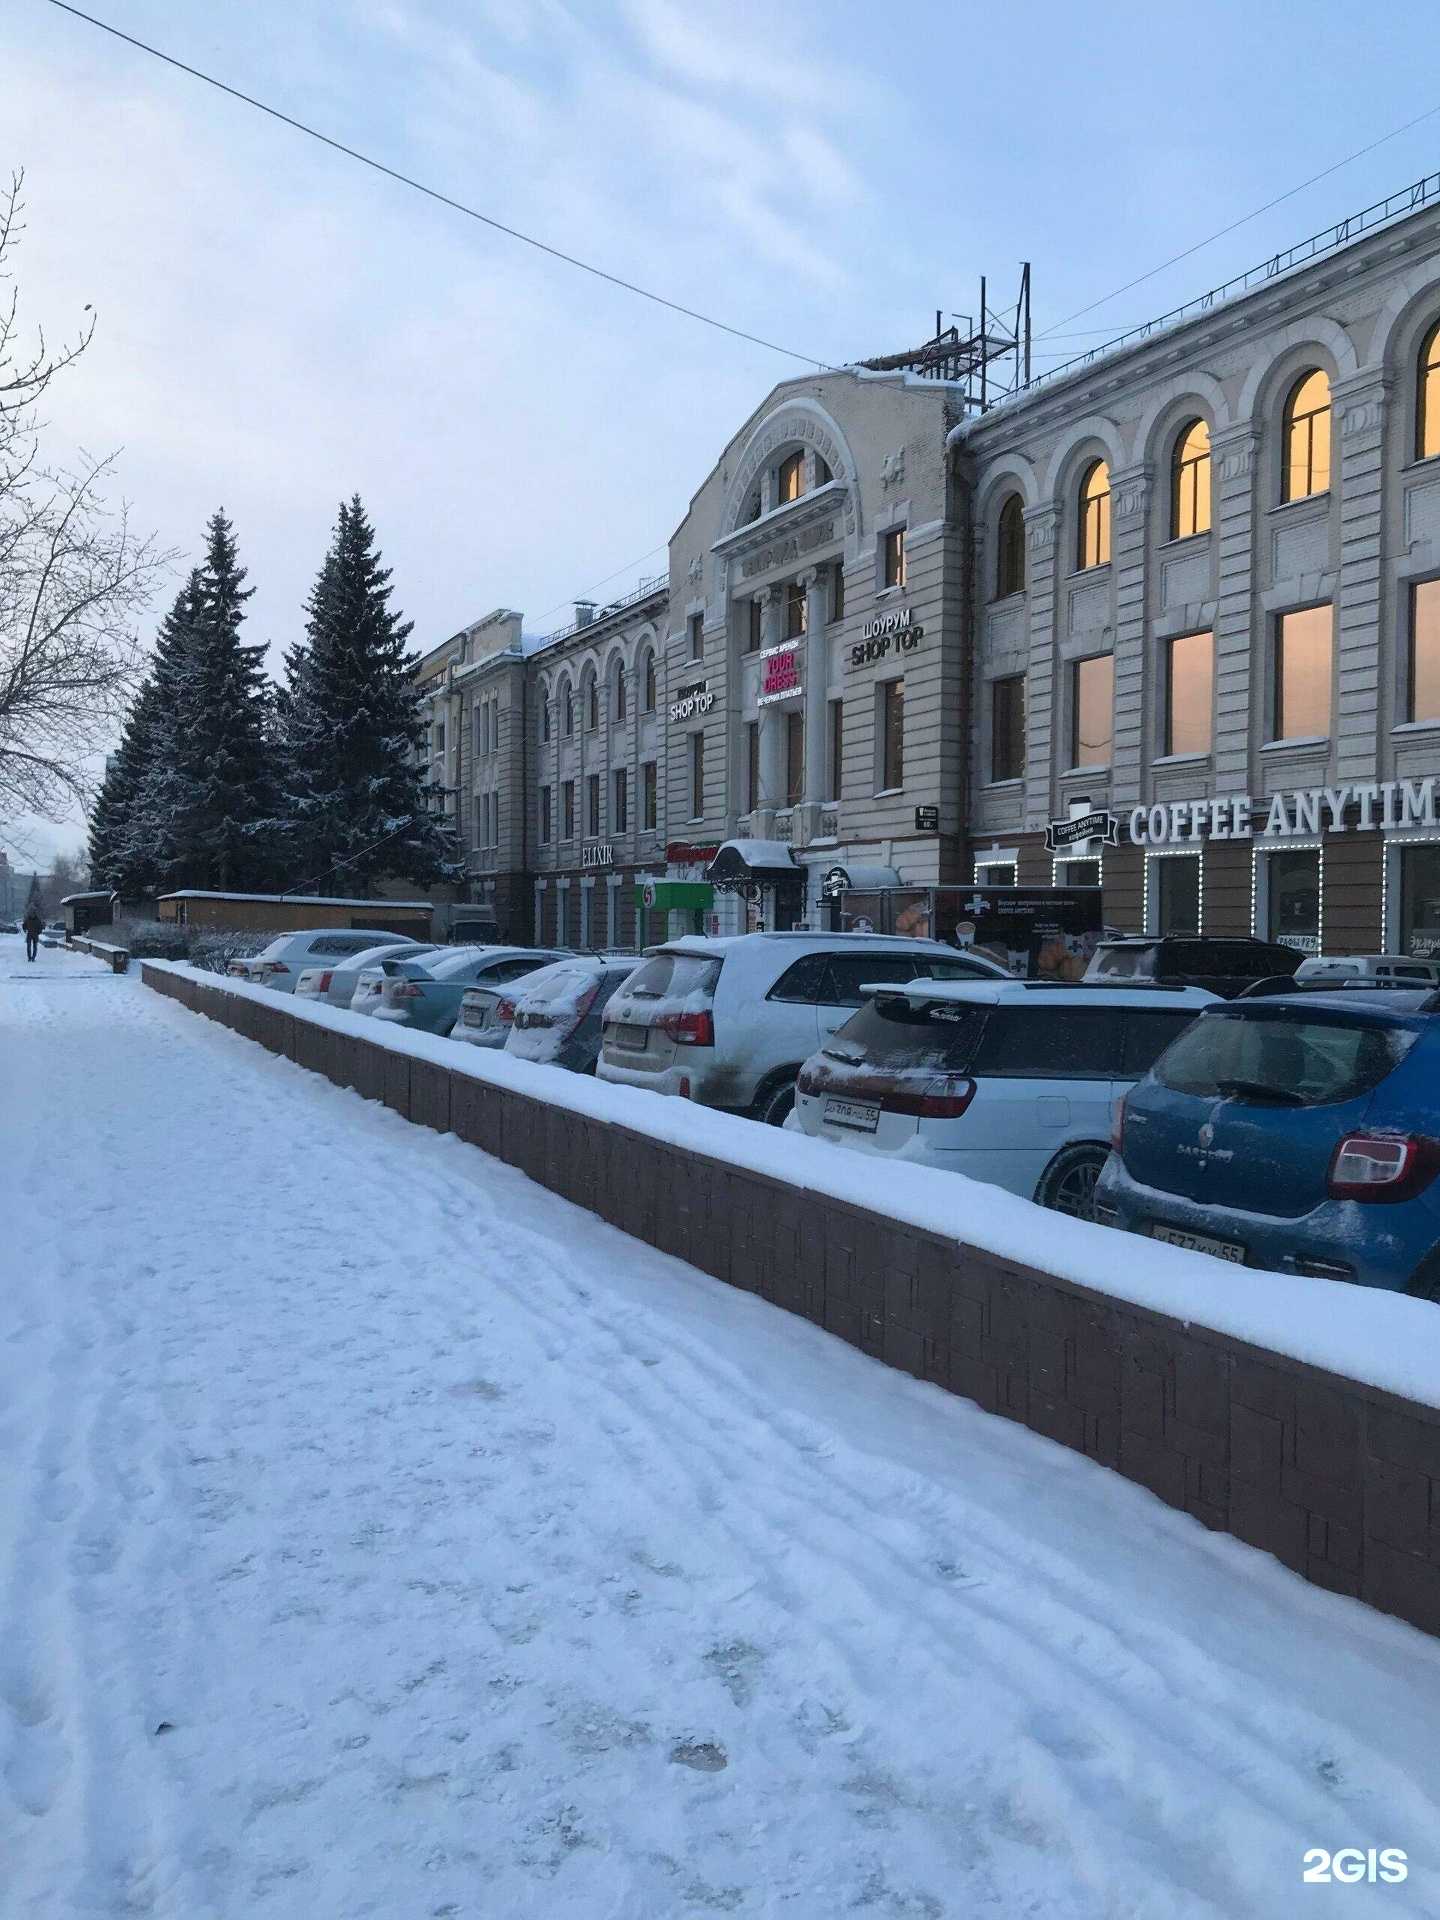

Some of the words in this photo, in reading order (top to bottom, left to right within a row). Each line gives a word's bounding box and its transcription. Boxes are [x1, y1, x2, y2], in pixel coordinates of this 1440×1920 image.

[863, 608, 911, 640] ШОУРУМ
[852, 636, 891, 666] SHOP
[893, 626, 924, 653] TOP
[768, 652, 794, 673] YOUR
[670, 700, 694, 721] SHOP
[694, 693, 713, 717] TOP
[1058, 823, 1077, 835] COFFEE
[1077, 816, 1104, 830] ANYTIME
[1129, 794, 1251, 846] COFFEE
[582, 844, 614, 867] ELIXIR
